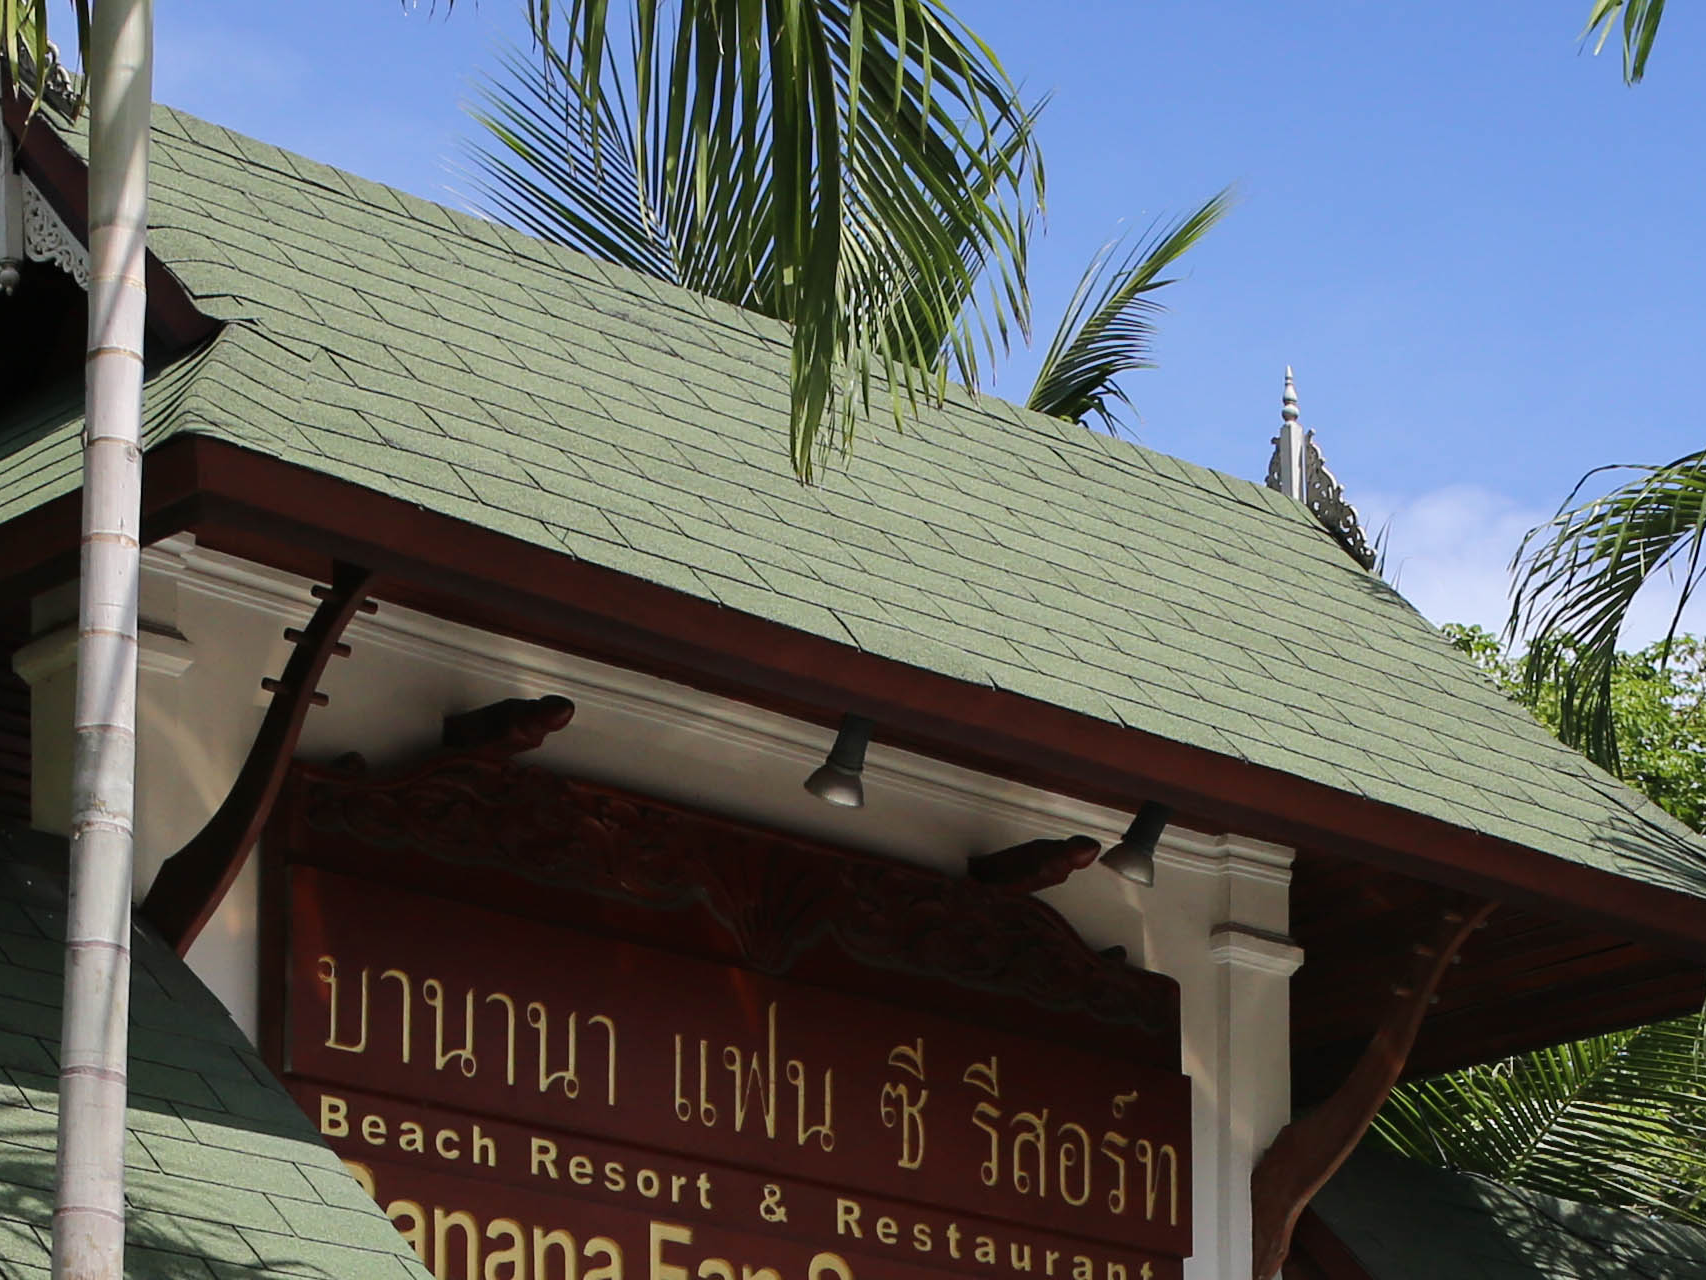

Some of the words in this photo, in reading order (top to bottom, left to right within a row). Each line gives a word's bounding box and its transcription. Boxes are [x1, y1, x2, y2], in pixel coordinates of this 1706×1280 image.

[318, 955, 615, 1106] บานานา
[674, 1001, 835, 1152] แฟน
[881, 1037, 928, 1170] ซี
[963, 1056, 1178, 1226] รีสอร์ท
[320, 1094, 497, 1167] Beach
[530, 1136, 712, 1209] Resort
[759, 1183, 788, 1222] &
